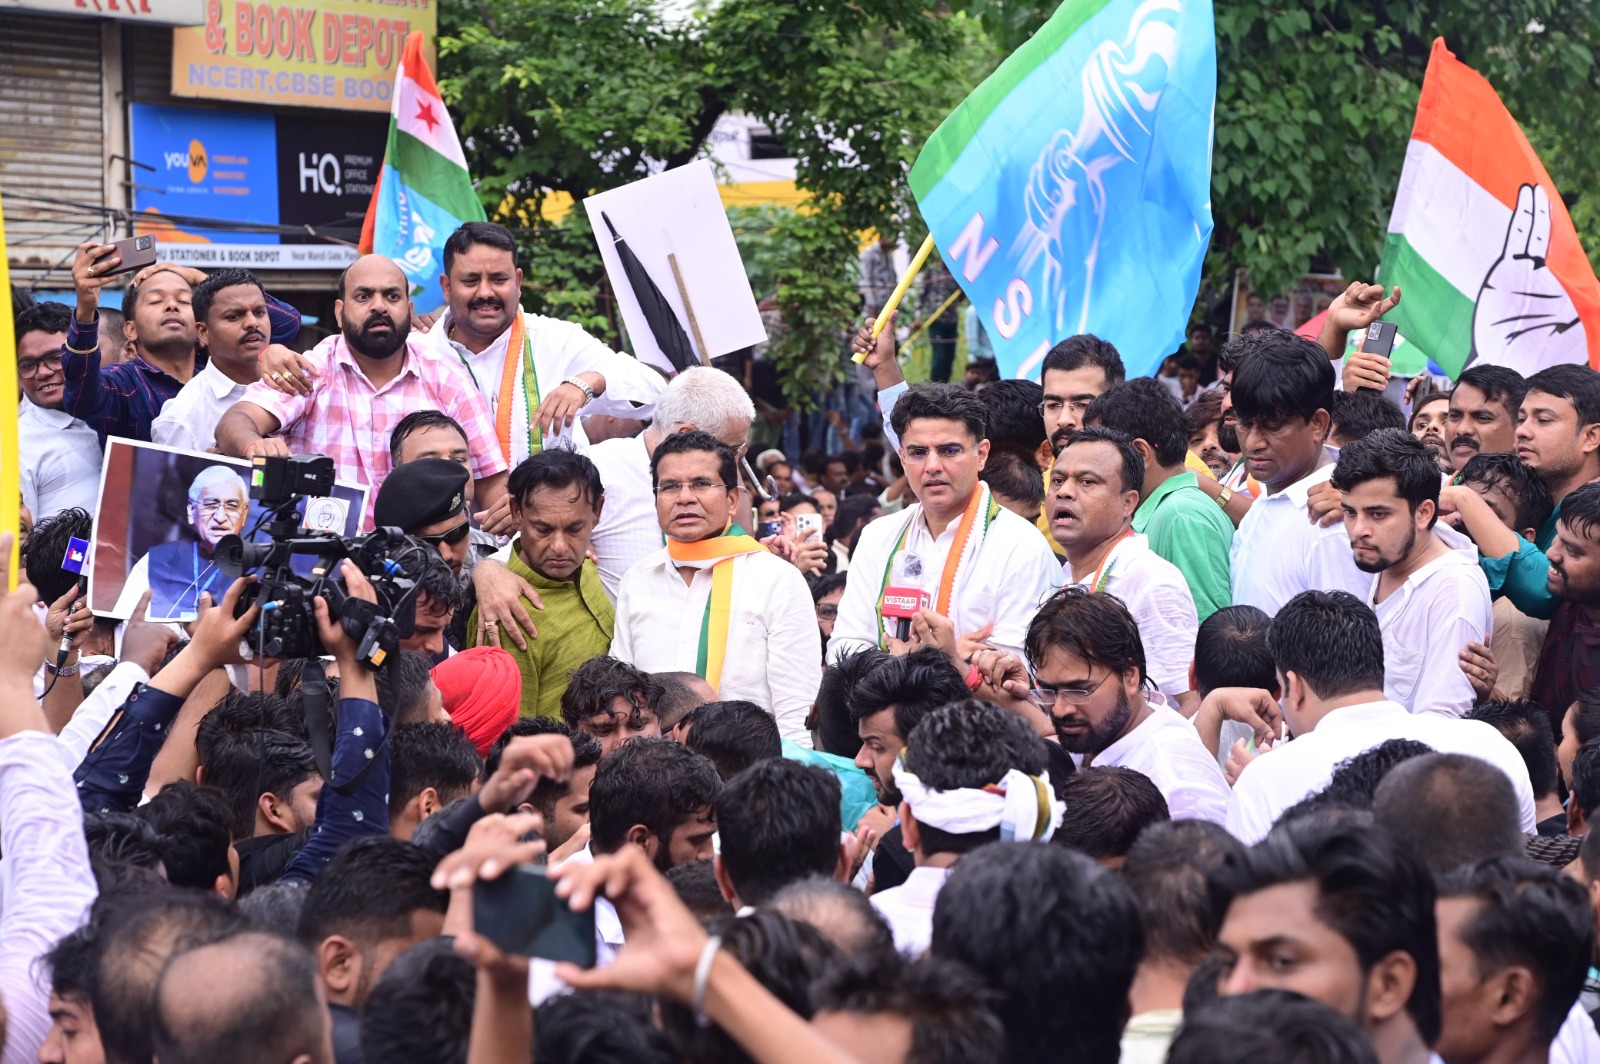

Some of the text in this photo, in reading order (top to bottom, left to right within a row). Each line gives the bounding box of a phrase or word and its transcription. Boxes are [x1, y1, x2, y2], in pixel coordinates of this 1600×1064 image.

[235, 1, 316, 63] BOOK
[322, 11, 410, 69] DEPOT
[188, 64, 394, 101] NCERT,CBSE BOO
[344, 154, 373, 166] PREMIUM
[344, 169, 368, 181] OFFICE
[169, 249, 217, 262] STATIONER
[228, 250, 251, 263] BOOK
[254, 251, 280, 263] DEPOT
[886, 597, 916, 605] VISTAAR
